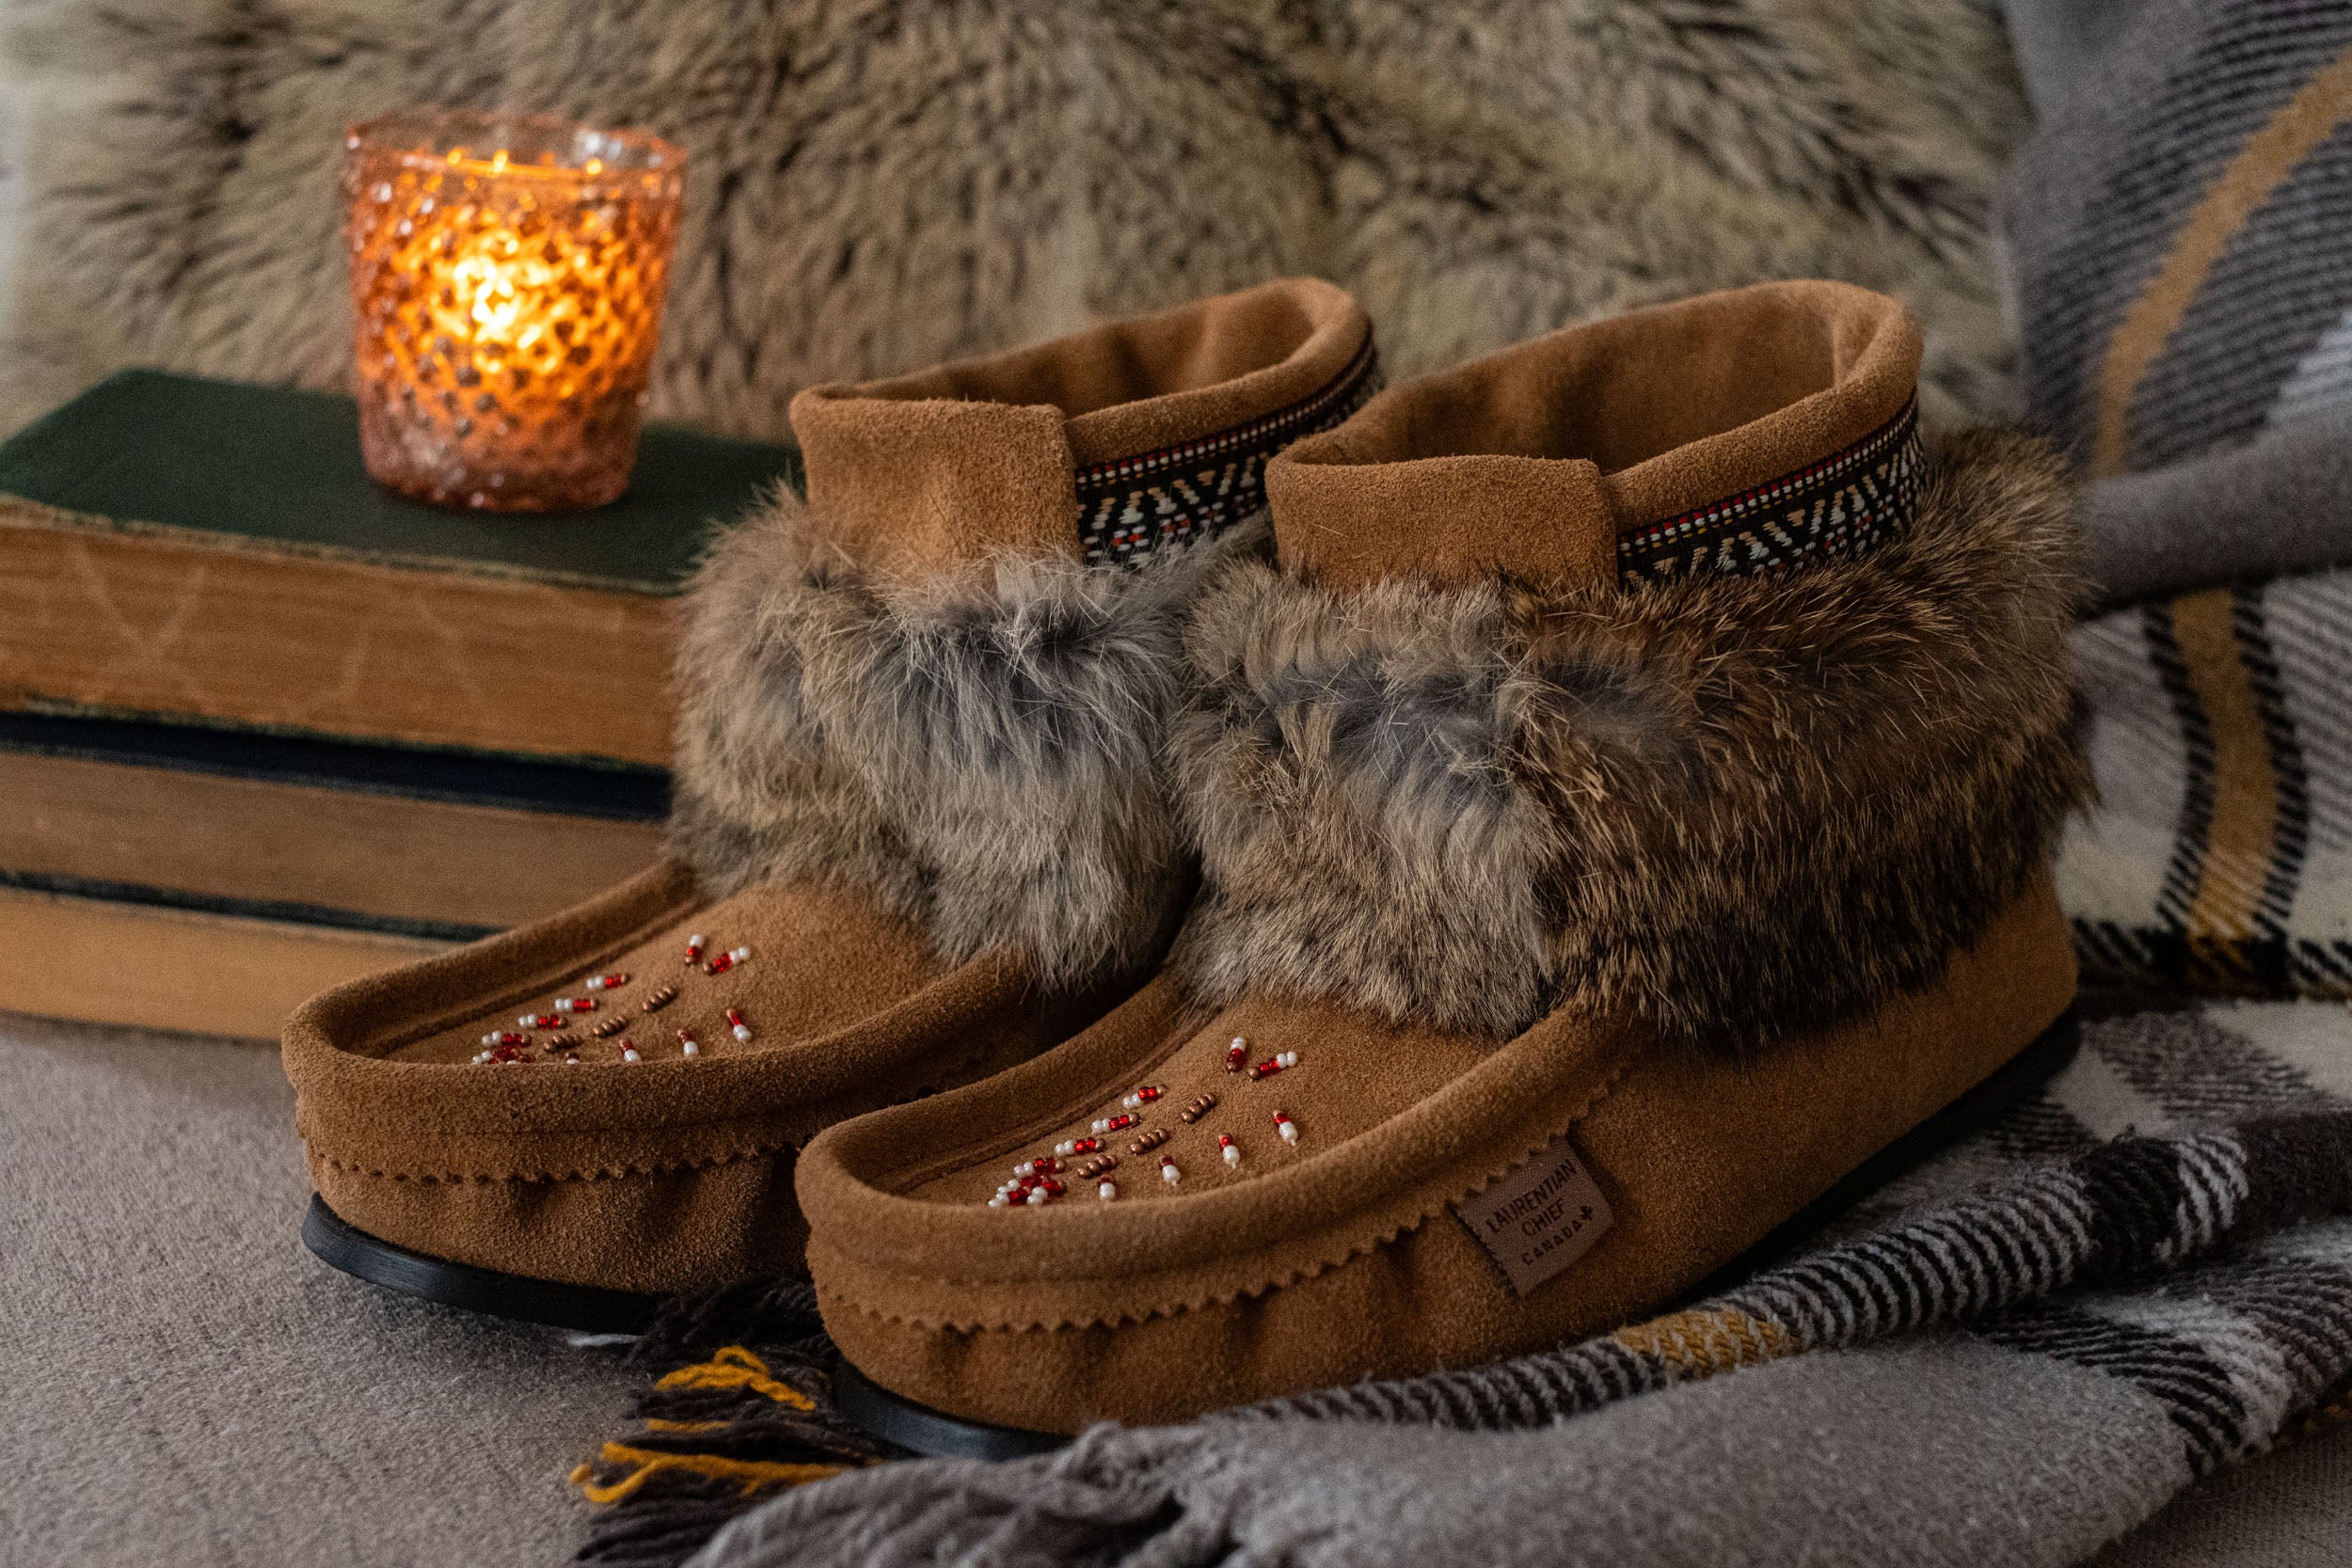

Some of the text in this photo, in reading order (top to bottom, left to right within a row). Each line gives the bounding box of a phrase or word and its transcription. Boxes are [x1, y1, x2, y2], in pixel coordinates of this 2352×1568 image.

[1485, 1158, 1577, 1235] LAURENTIAN
[1522, 1198, 1565, 1236] CHIEF
[1522, 1220, 1582, 1266] CANADA
